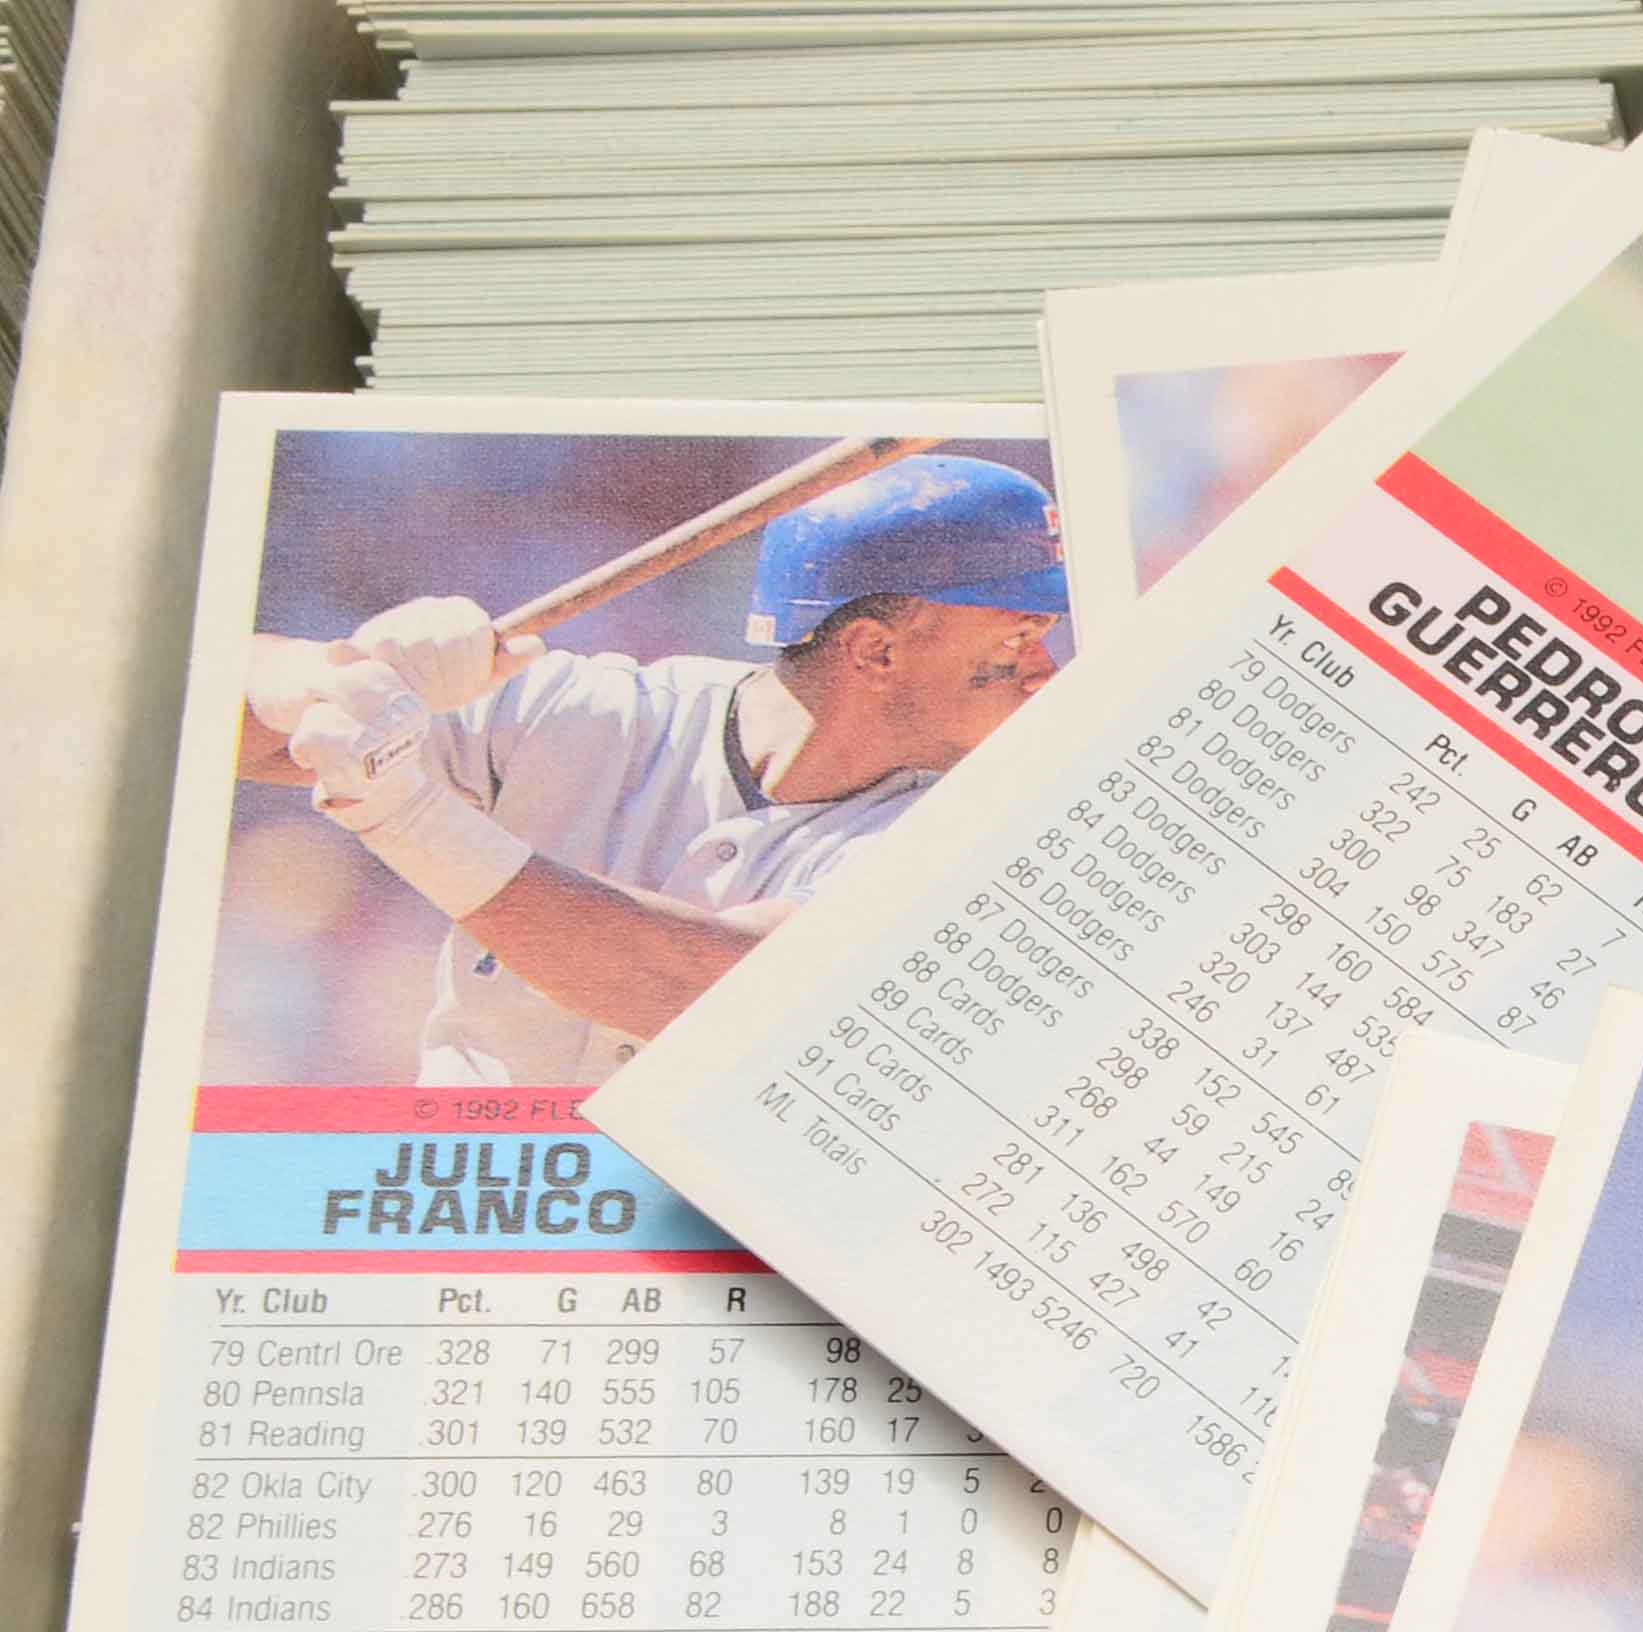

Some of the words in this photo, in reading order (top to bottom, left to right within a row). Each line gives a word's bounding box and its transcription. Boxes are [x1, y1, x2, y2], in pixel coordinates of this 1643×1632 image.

[1572, 597, 1628, 645] 1992
[1227, 648, 1267, 683] 79
[1260, 674, 1358, 755] Dodgers
[1267, 611, 1298, 647] Yr.
[1297, 638, 1357, 690] Club
[1422, 731, 1470, 778] Pct.
[371, 1141, 592, 1193] JULIO
[322, 1187, 639, 1236] FRANCO
[213, 1286, 247, 1315] Yr.
[260, 1285, 329, 1312] Club
[436, 1286, 492, 1315] Pct.
[191, 1470, 230, 1500] 82
[240, 1470, 303, 1501] Okla
[316, 1469, 373, 1506] City
